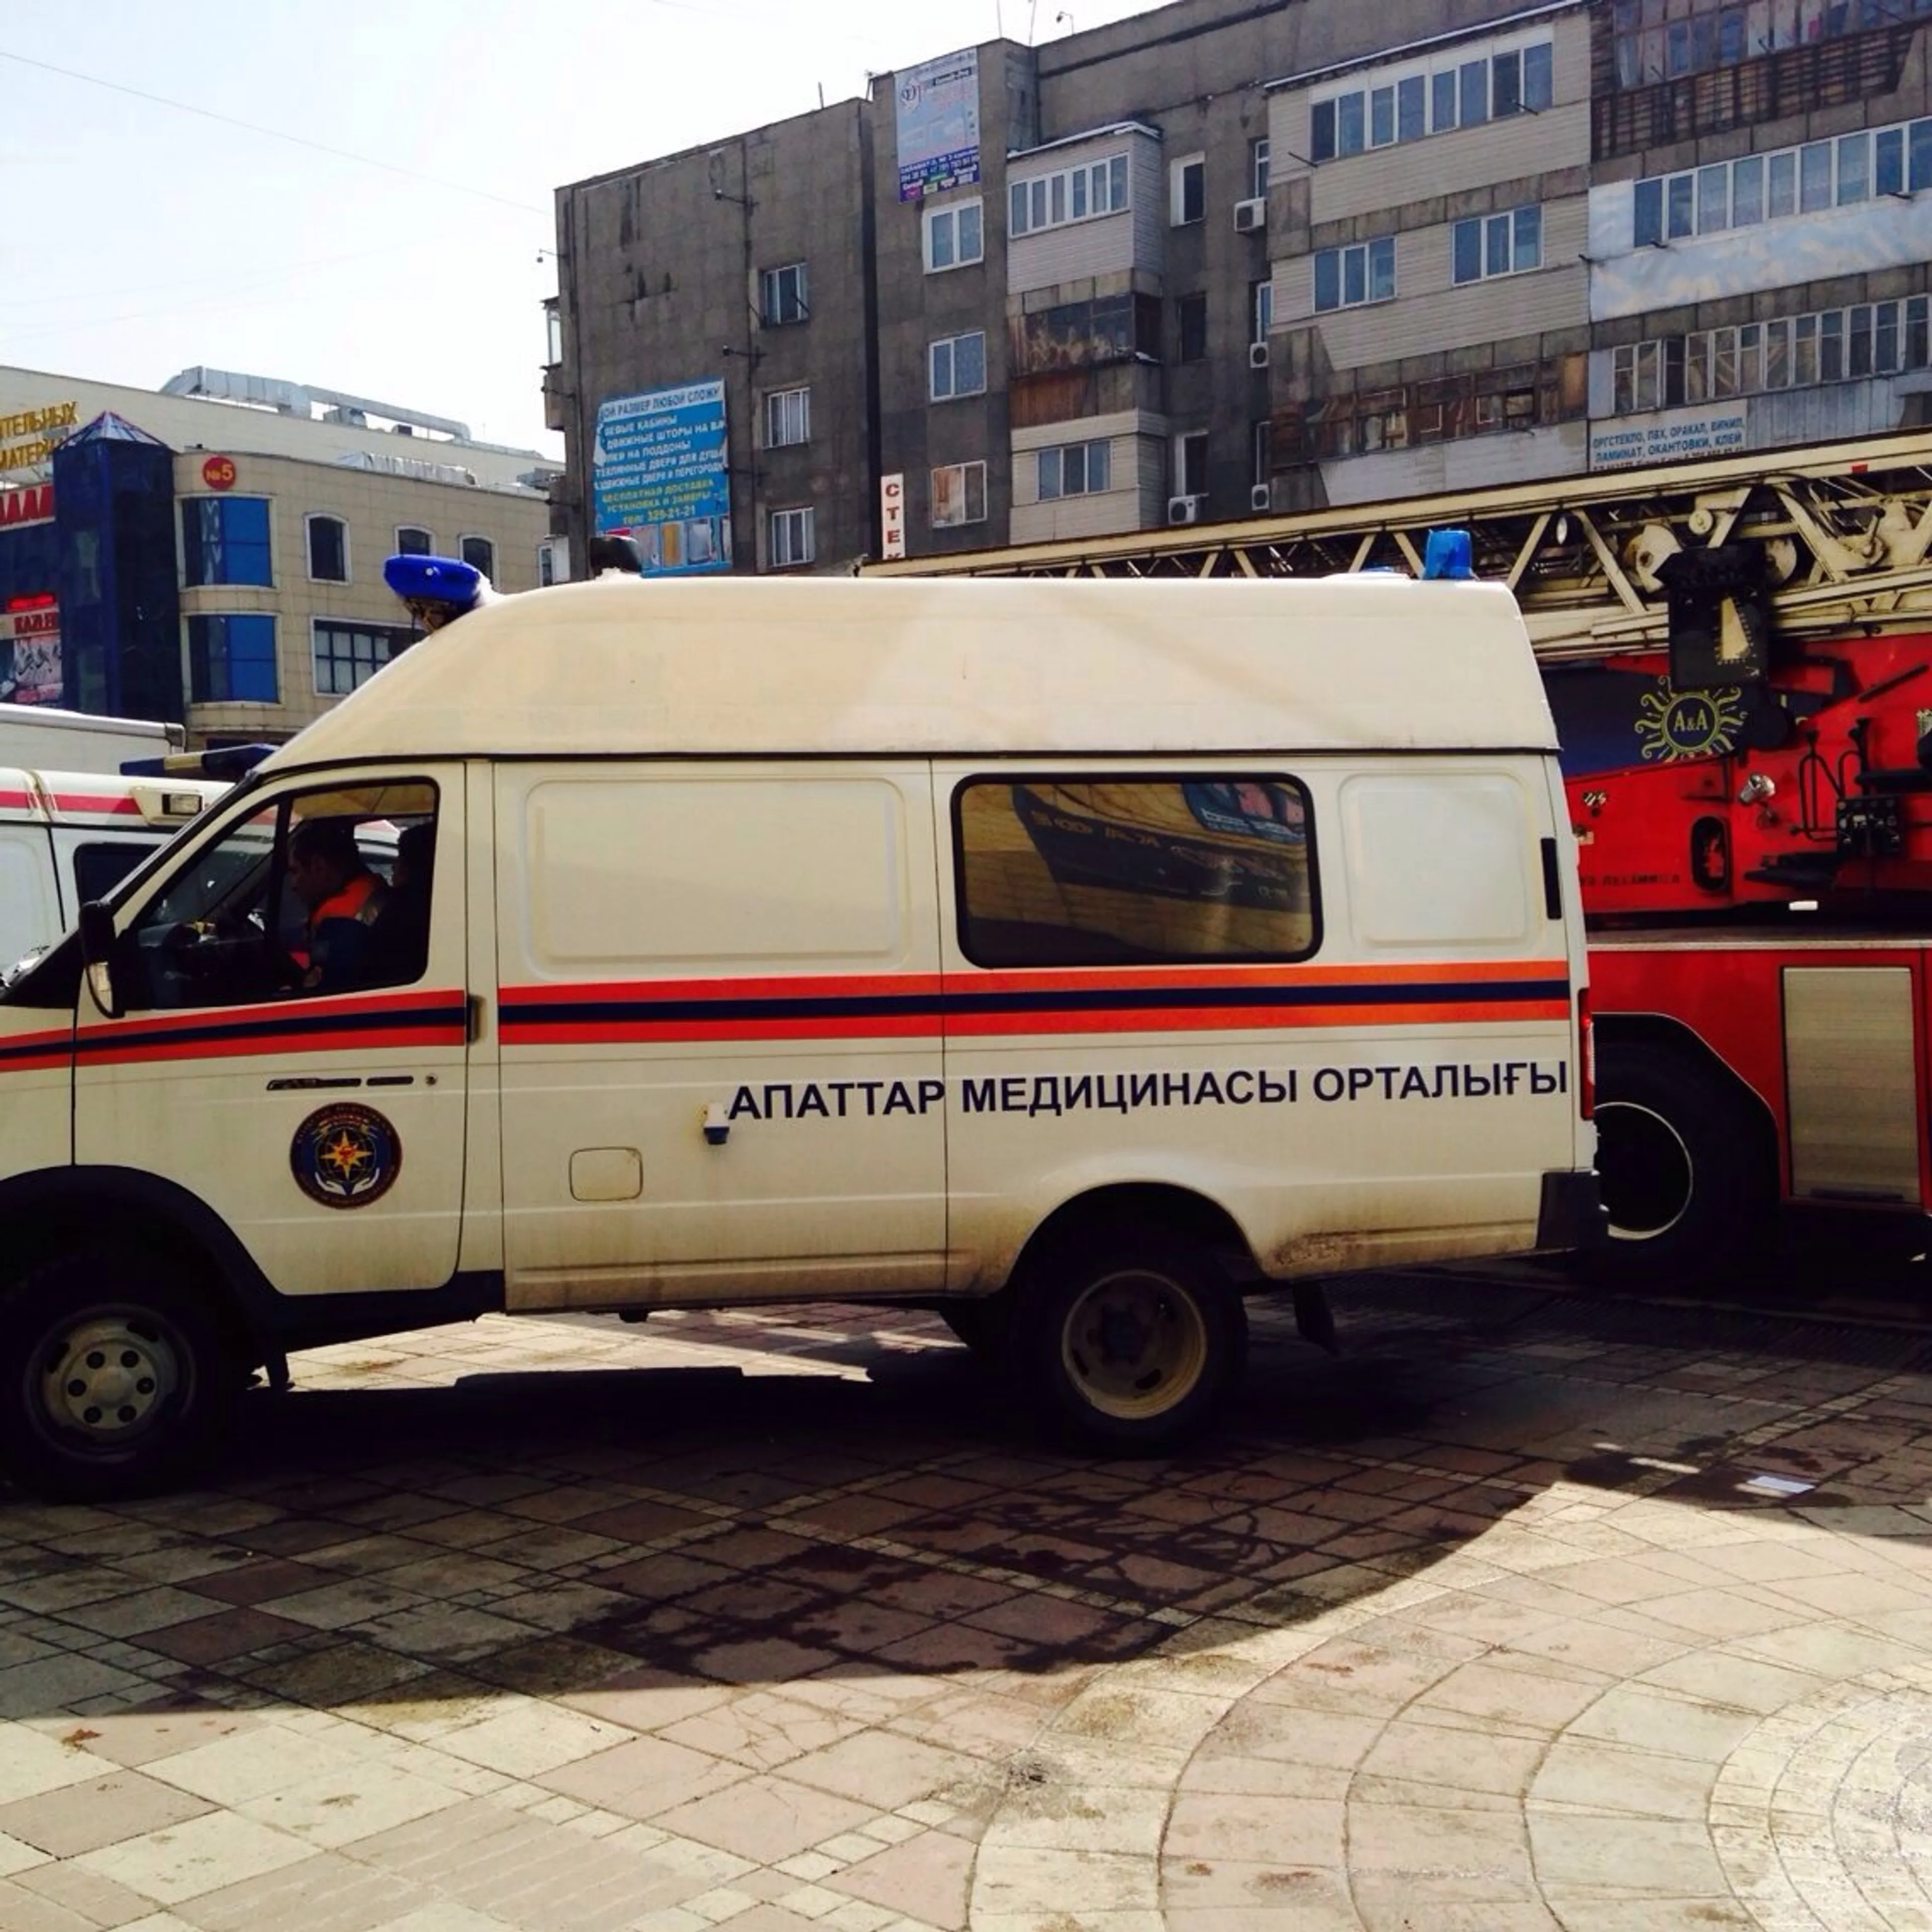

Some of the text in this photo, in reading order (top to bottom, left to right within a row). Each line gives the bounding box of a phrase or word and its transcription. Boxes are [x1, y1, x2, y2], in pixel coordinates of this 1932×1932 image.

[0, 401, 77, 437] ТЕЛЬНЫХ
[695, 423, 708, 433] НА
[1593, 431, 1645, 448] ОРГСТЕКЛО,
[1648, 429, 1668, 441] ПВХ,
[1670, 423, 1708, 437] ОРАКАЛ,
[1595, 447, 1646, 463] ЛАМИНАТ,
[1648, 437, 1712, 455] ОКАНТОВКИ,
[1715, 431, 1742, 446] КЛЕЙ
[627, 450, 640, 459] НА
[728, 1061, 1567, 1120] АПАТТАР МЕДИЦИНАСЫ ОРТАЛЫҒЫ
